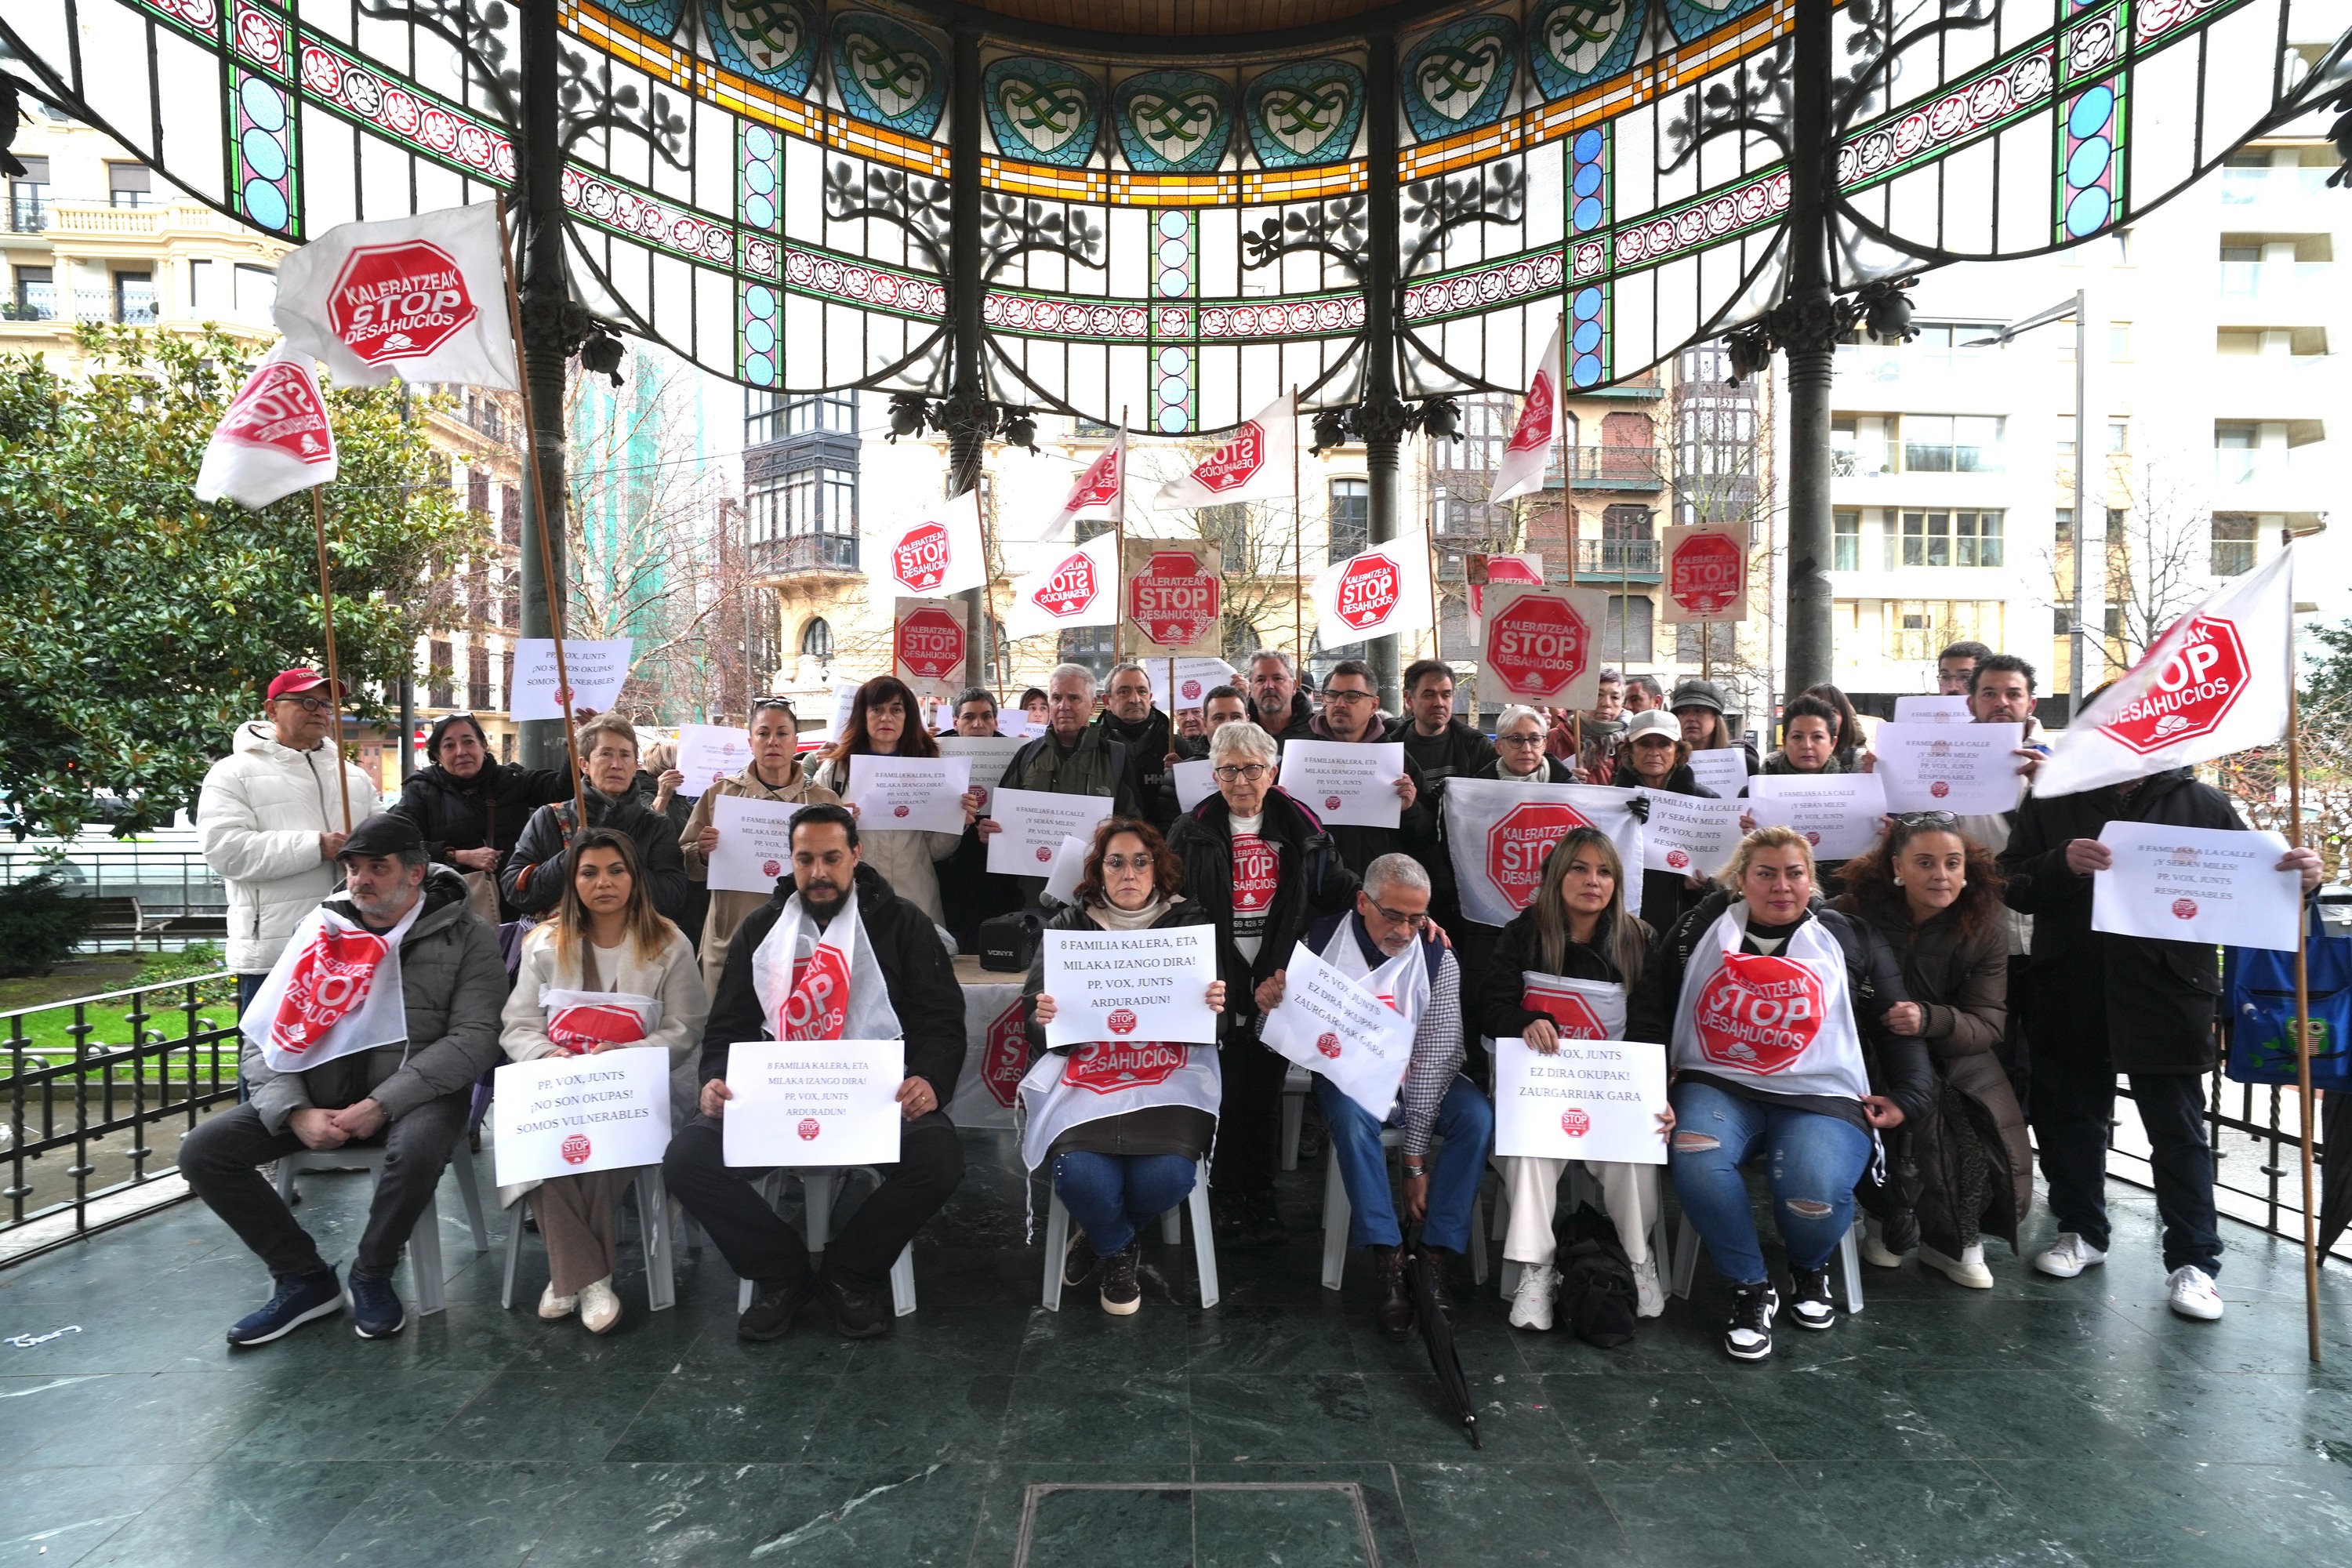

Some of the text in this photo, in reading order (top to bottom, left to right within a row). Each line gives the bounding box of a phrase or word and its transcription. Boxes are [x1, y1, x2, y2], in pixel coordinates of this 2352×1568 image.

[343, 269, 459, 307] KALERATZEAK
[350, 289, 461, 330] STOP
[344, 312, 455, 345] DESAHUCIOS
[1138, 577, 1207, 586] KALERATZEAK
[1345, 566, 1392, 585] KALERATZEAK
[1675, 564, 1738, 583] STOP
[1343, 575, 1392, 604] STOP
[1139, 587, 1208, 609] STOP
[1342, 593, 1393, 615] DESAHUCIOS
[1139, 609, 1208, 619] DESAHUCIOS
[905, 626, 956, 635] KALERATZEAK
[1502, 620, 1577, 636] KALERATZEAK
[905, 633, 957, 652] STOP
[1499, 631, 1577, 658] STOP
[904, 650, 956, 659] DESAHUCIOS
[1498, 654, 1573, 671] DESAHUCIOS
[2107, 677, 2230, 726] DESAHUCIOS
[1652, 796, 1693, 809] FAMILIAS
[1668, 813, 1699, 824] SERÁN
[1672, 827, 1693, 838] VOX,
[1653, 838, 1720, 852] RESPONSABLES
[1669, 853, 1688, 862] STOP
[1233, 855, 1274, 880] TOP
[2154, 887, 2234, 899] RESPONSABLES
[1060, 936, 1198, 950] 8 FAMILIA KALERA, ETA
[1063, 956, 1196, 971] MILAKA IZANGO DIRA!
[1087, 977, 1173, 990] PP, VOX, JUNTS
[1091, 996, 1171, 1007] ARDURADUN!
[1308, 982, 1344, 1009] EZ DIRA
[1352, 993, 1381, 1015] JUNTS
[1710, 983, 1812, 1029] STOP
[1110, 1014, 1134, 1024] STOP
[1701, 1009, 1806, 1051] DESAHUCIOS
[1078, 1047, 1178, 1076] DESAHUCIOS
[1586, 1050, 1622, 1060] JUNTS
[538, 1071, 625, 1090] PP, VOX, JUNTS
[1530, 1067, 1630, 1080] EZ DIRA OKUPAK!
[530, 1090, 633, 1113] ¡NO SON OKUPAS!
[1519, 1087, 1642, 1102] ZAURGARRIAK GARA
[516, 1108, 649, 1134] SOMOS VULNERABLES
[1563, 1115, 1588, 1123] STOP
[564, 1141, 588, 1152] STOP
